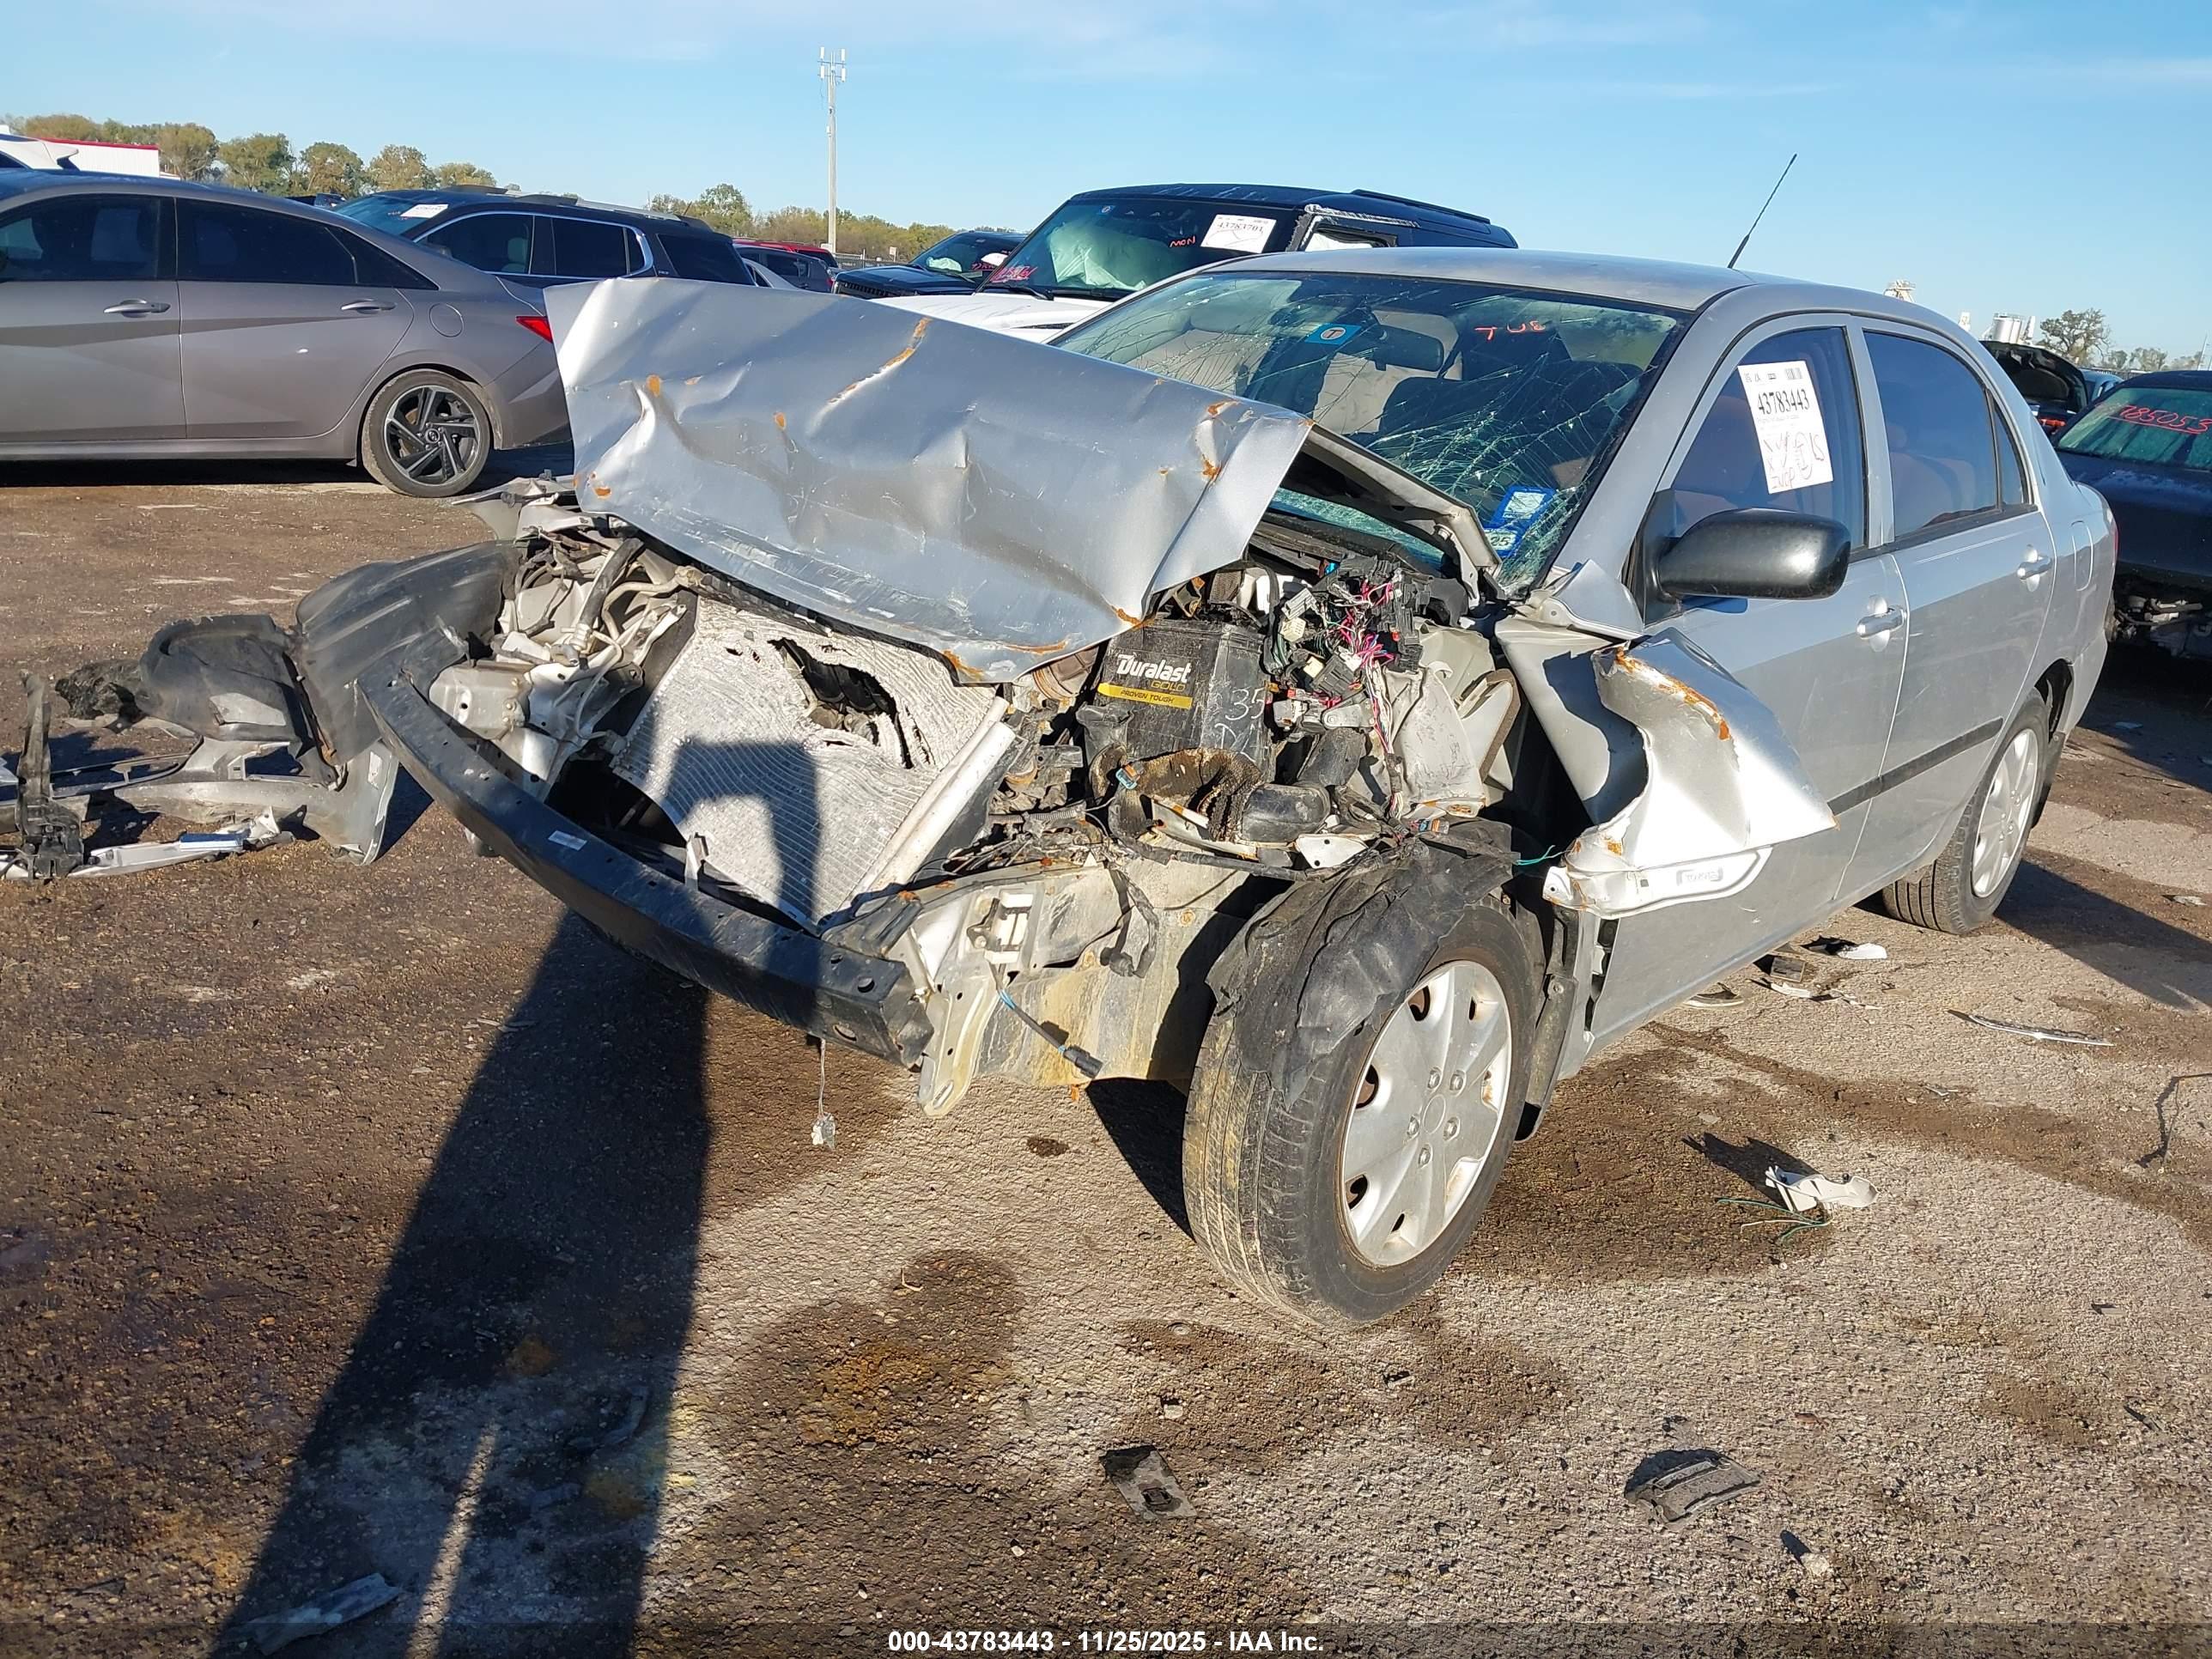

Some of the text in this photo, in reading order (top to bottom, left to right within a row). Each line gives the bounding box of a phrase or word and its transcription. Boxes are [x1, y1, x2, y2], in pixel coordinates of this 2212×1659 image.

[1169, 234, 1196, 248] MON
[1757, 388, 1810, 415] 43783443
[1116, 653, 1193, 684] Duralast
[1151, 680, 1186, 692] GOLD
[1120, 689, 1176, 703] PROVEN TOUGH
